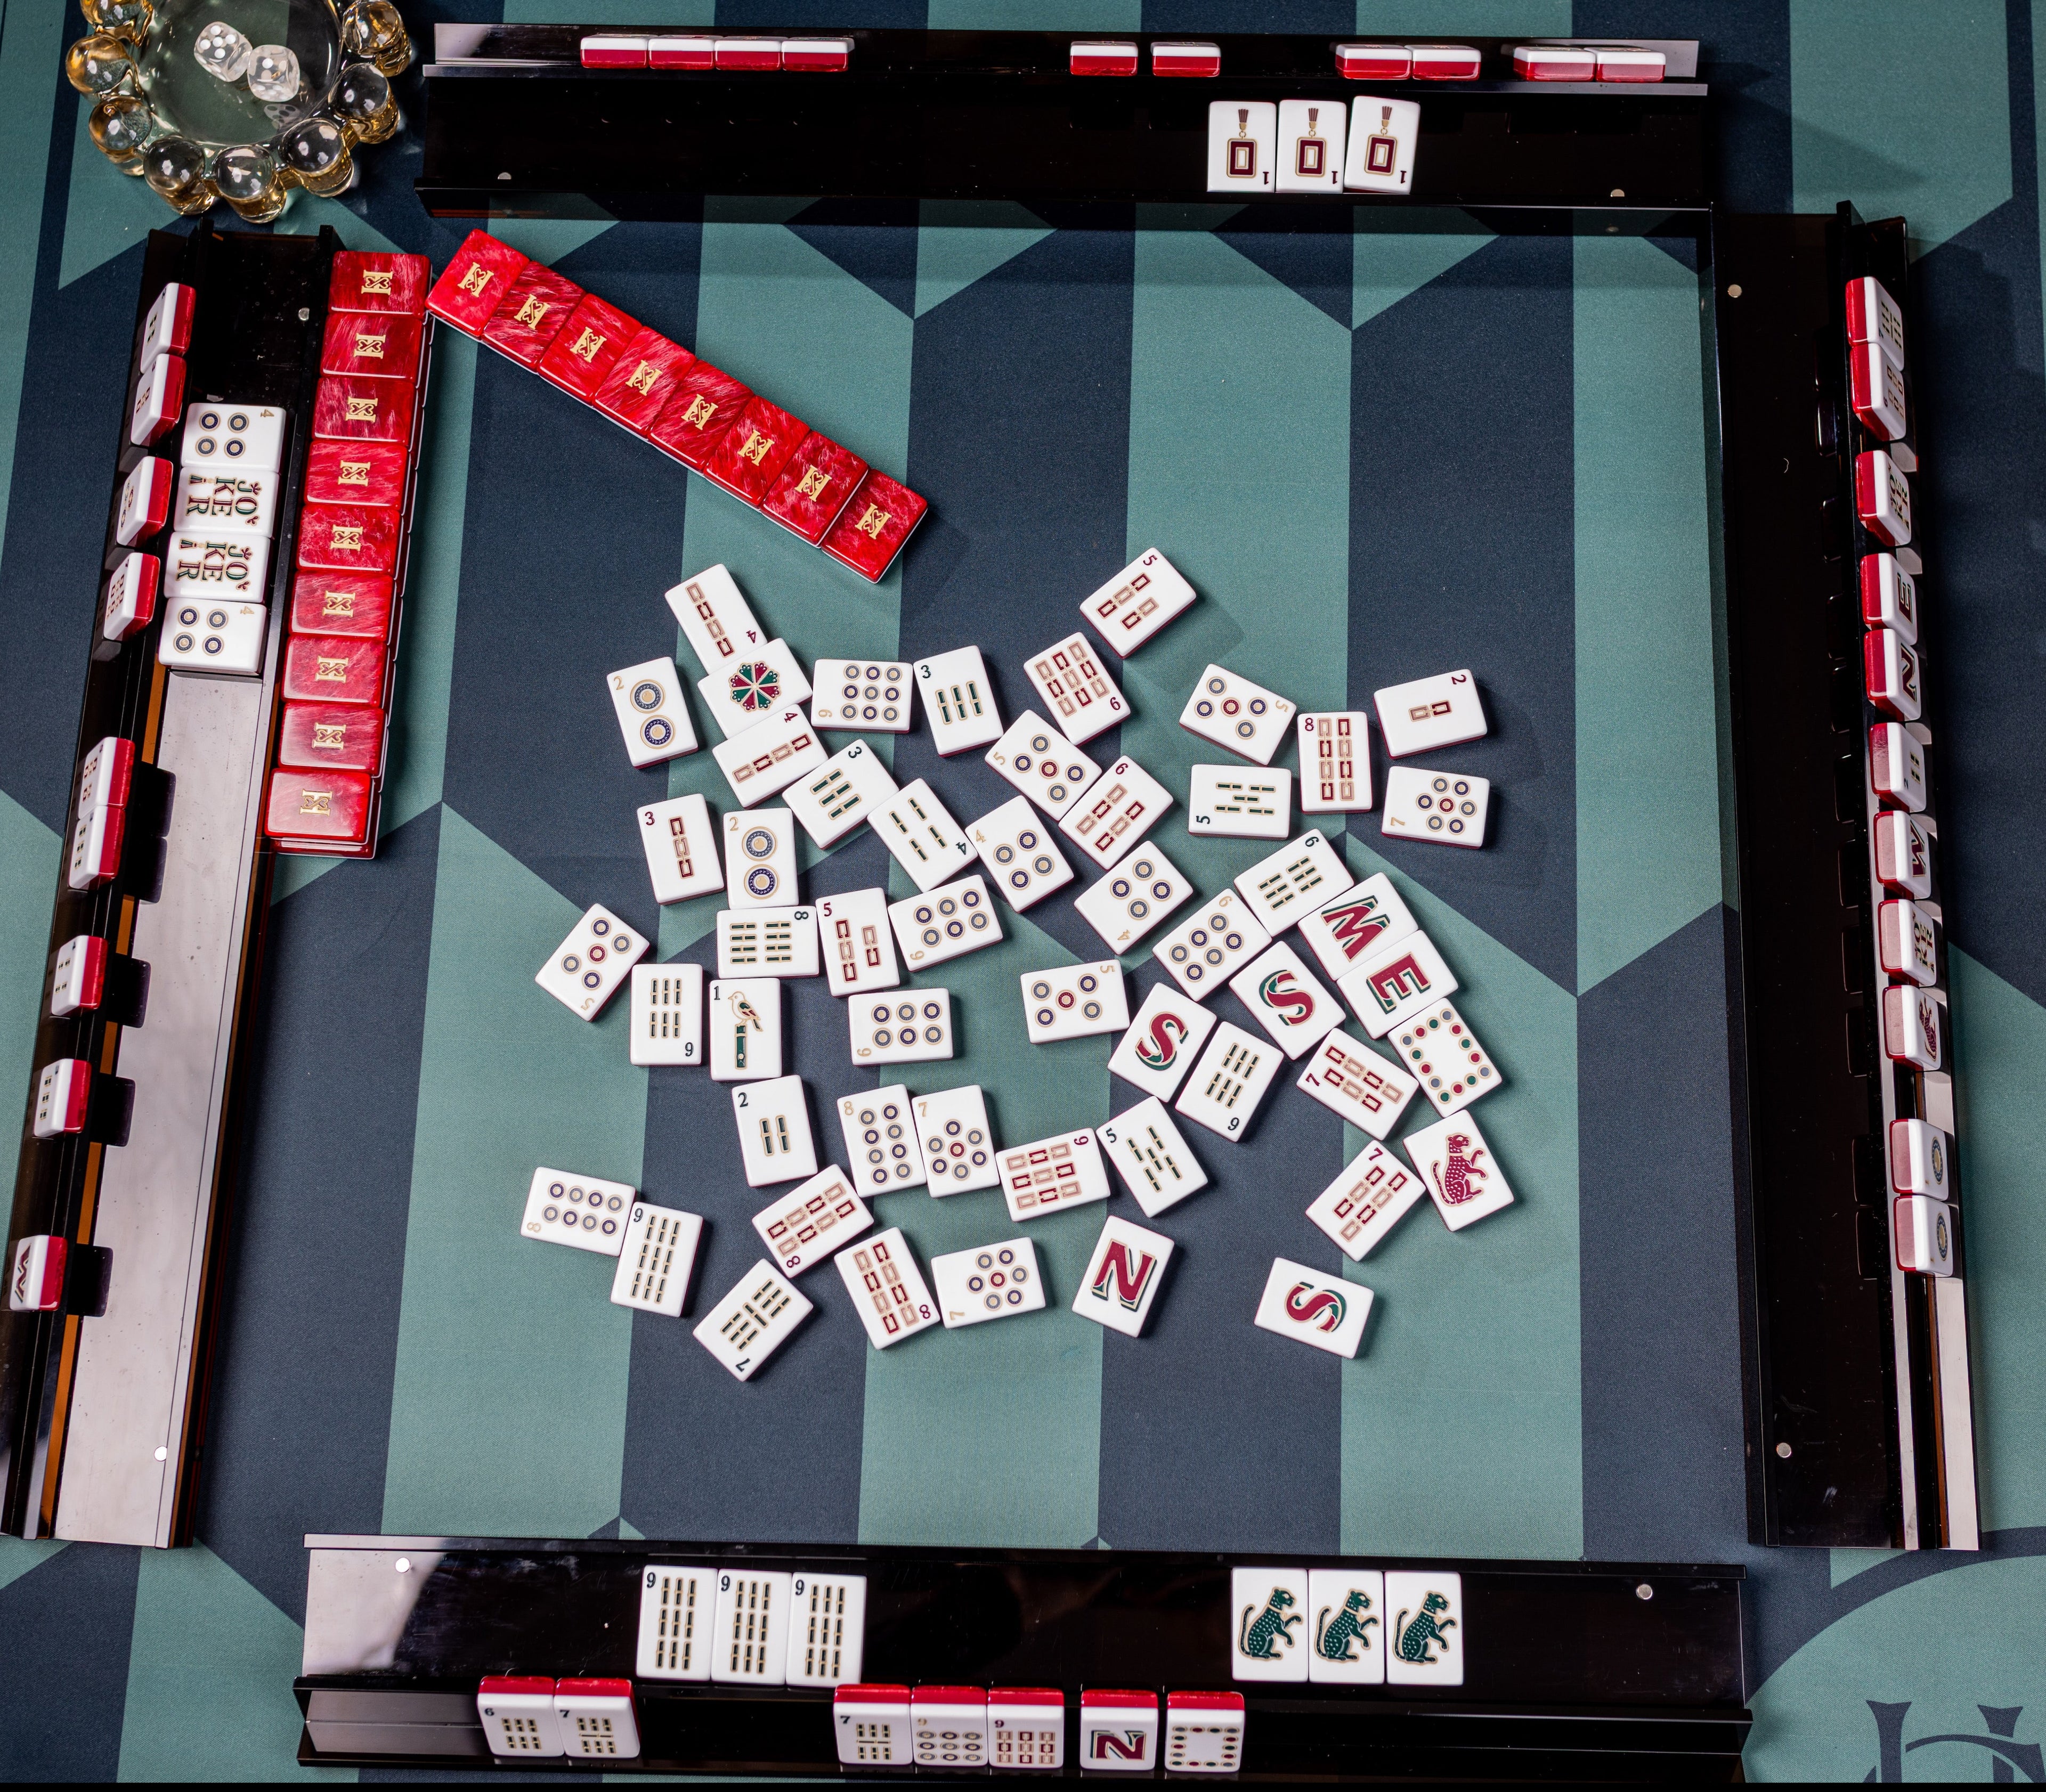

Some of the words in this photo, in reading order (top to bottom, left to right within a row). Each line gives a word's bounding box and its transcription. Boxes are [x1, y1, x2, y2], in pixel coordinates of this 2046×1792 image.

[1263, 171, 1269, 185] 1
[1331, 171, 1338, 184] 1
[1400, 170, 1407, 184] 1
[1143, 555, 1157, 565] 5
[1897, 572, 1913, 624] E
[746, 630, 756, 644] 4
[921, 665, 931, 679] 3
[1901, 642, 1917, 704] N
[614, 676, 624, 690] 2
[1451, 675, 1466, 685] 2
[1274, 700, 1289, 713] 5
[784, 713, 798, 722] 4
[1305, 718, 1314, 731] 8
[848, 745, 862, 759] 3
[993, 752, 1005, 765] 5
[645, 812, 655, 825] 3
[729, 817, 738, 831] 2
[1196, 816, 1210, 824] 5
[1391, 817, 1405, 826] 7
[976, 829, 986, 843] 4
[956, 842, 966, 855] 4
[1910, 820, 1926, 877] W
[794, 911, 809, 920] 8
[824, 902, 832, 917] 5
[1117, 930, 1130, 940] 4
[1366, 951, 1431, 1014] E
[714, 986, 720, 1000] 1
[1259, 970, 1314, 1026] S
[580, 998, 595, 1011] 5
[1135, 1011, 1189, 1071] S
[1305, 1073, 1320, 1086] 7
[738, 1093, 748, 1107] 2
[844, 1101, 854, 1115] 8
[919, 1102, 927, 1117] 7
[1106, 1128, 1117, 1143] 5
[1369, 1147, 1383, 1161] 7
[527, 1222, 541, 1233] 8
[786, 1256, 800, 1268] 8
[1090, 1237, 1157, 1312] N
[919, 1305, 931, 1319] 8
[1284, 1281, 1346, 1333] S
[949, 1311, 965, 1321] 7
[736, 1358, 750, 1372] 7
[1090, 1730, 1146, 1760] N
